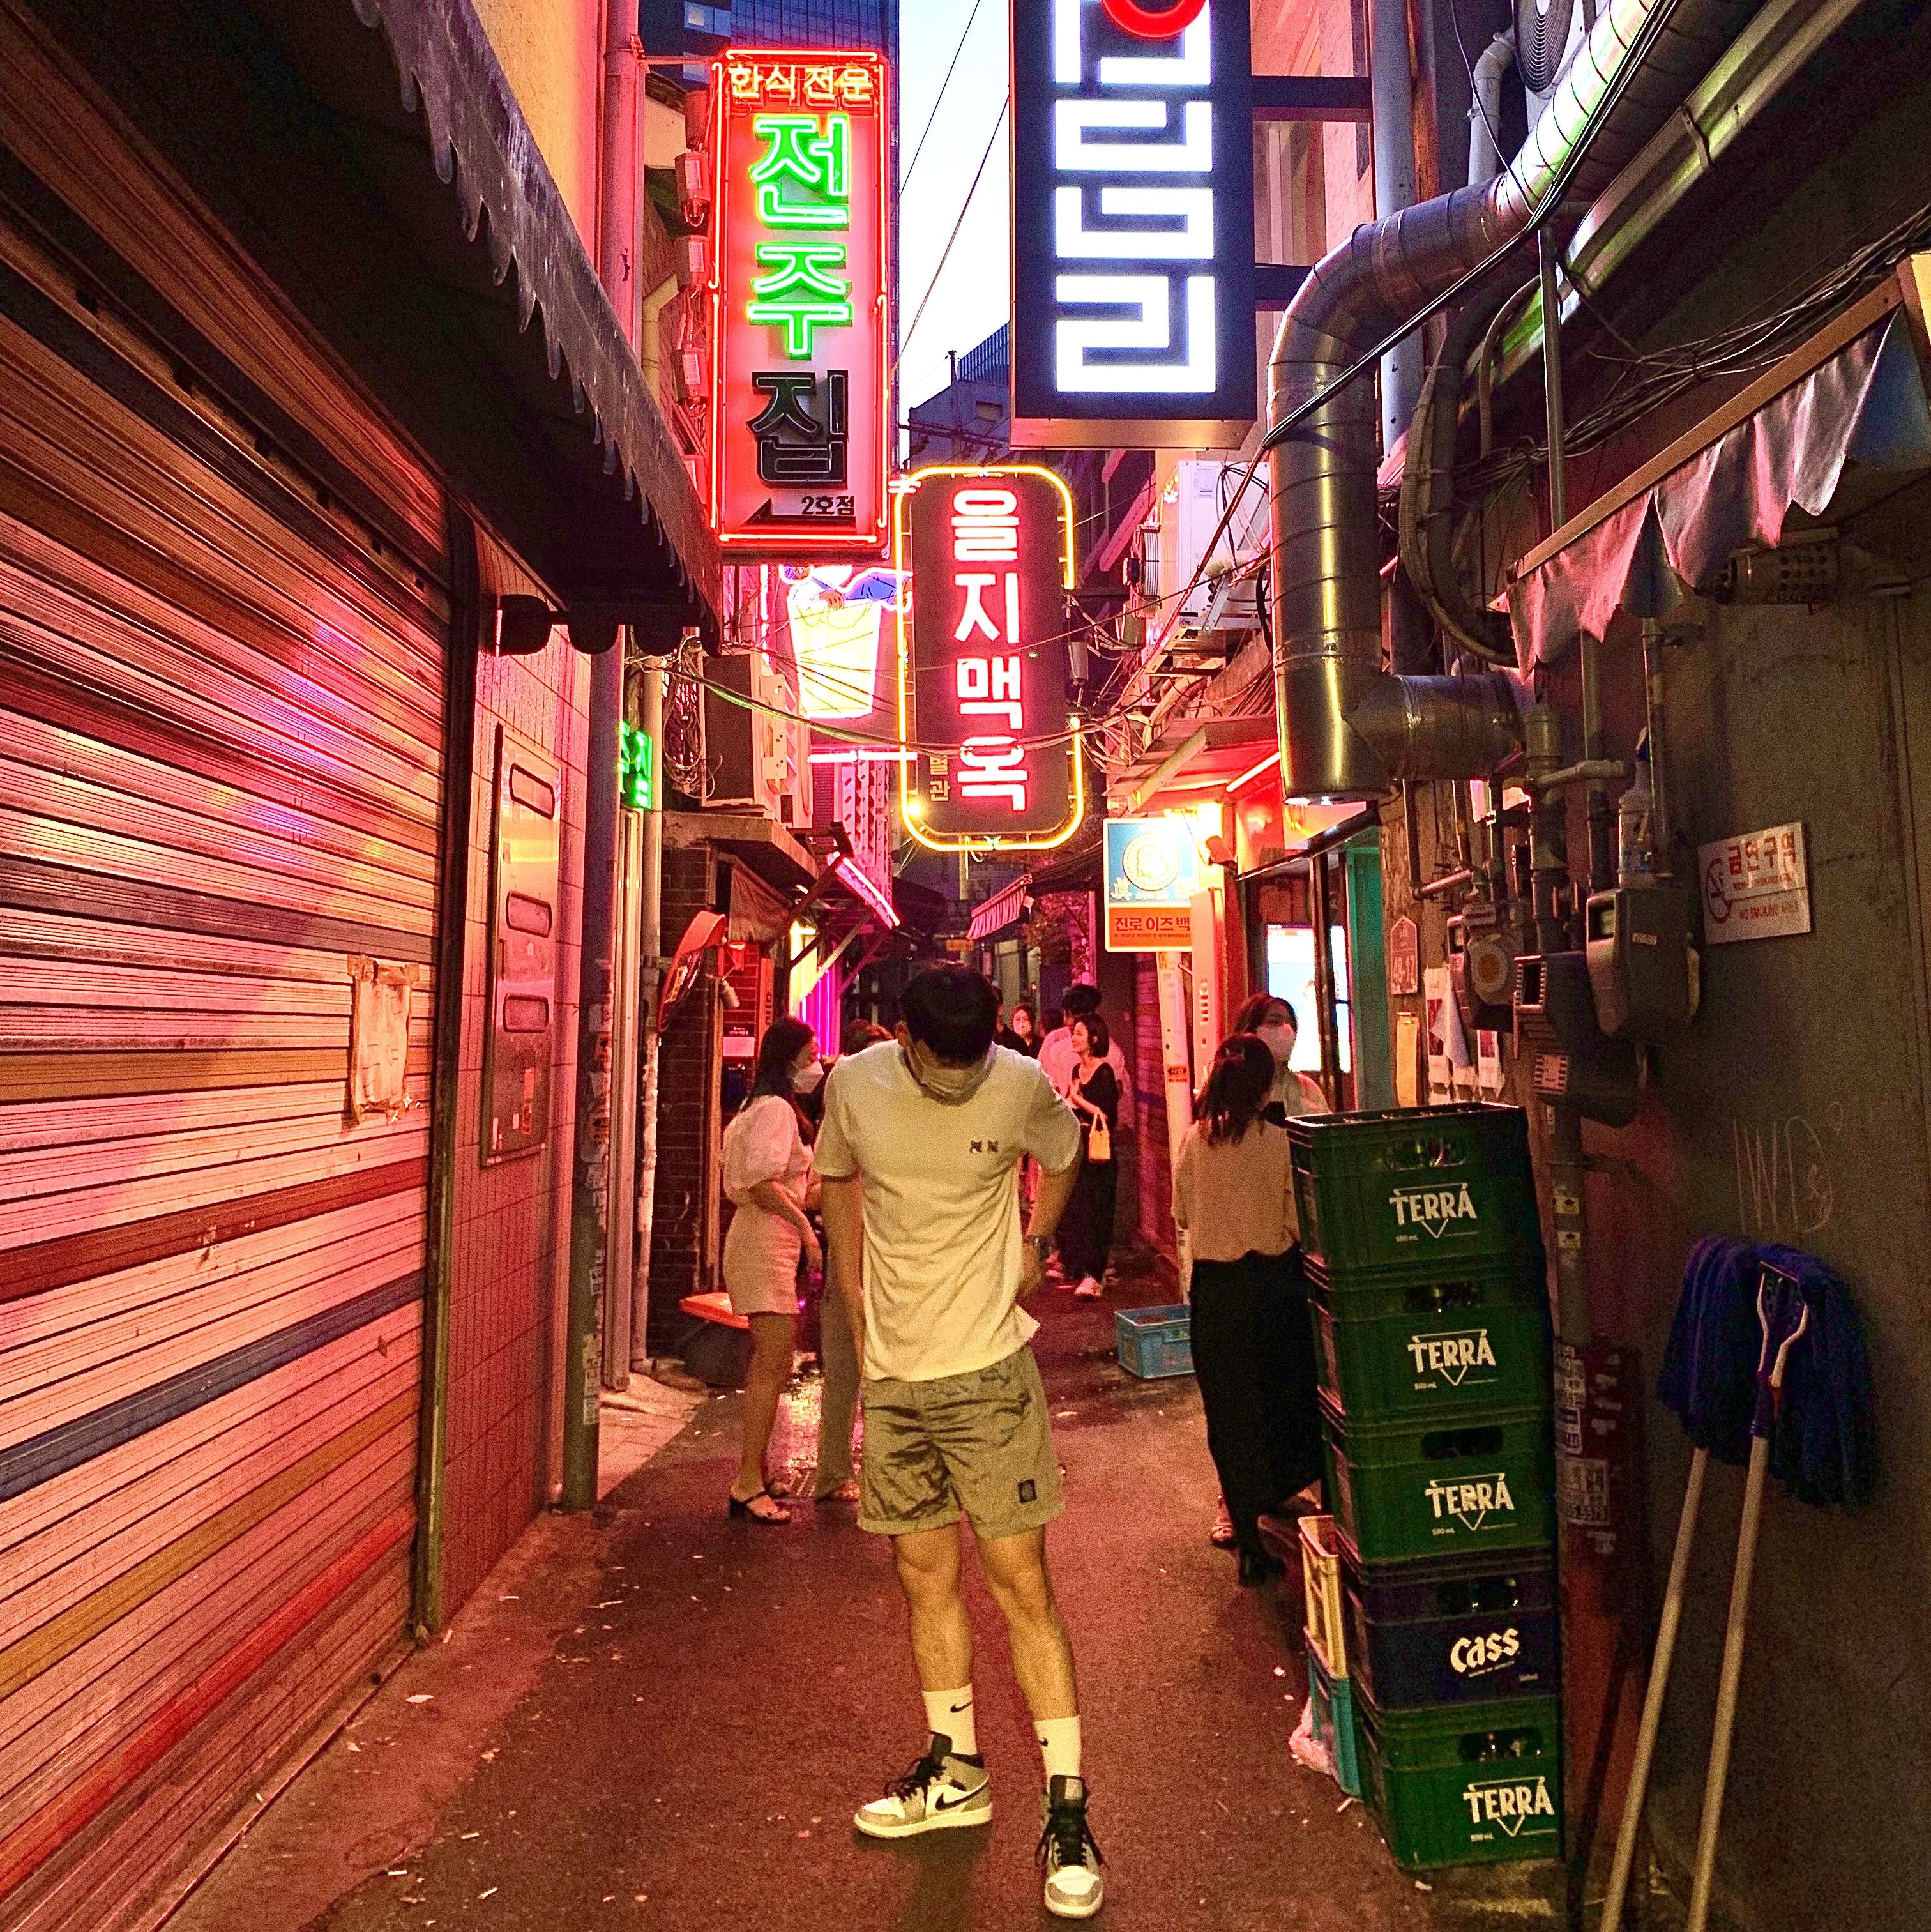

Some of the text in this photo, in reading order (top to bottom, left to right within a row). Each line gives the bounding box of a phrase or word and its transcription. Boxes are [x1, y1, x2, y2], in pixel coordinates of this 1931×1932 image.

[728, 63, 874, 100] 한식전문
[746, 114, 852, 489] 전주집
[801, 495, 855, 516] 2호점
[951, 488, 1028, 812] 을지맥옥
[929, 755, 951, 802] 별관
[1727, 831, 1797, 876] 금연구역
[1114, 917, 1143, 932] 진로
[1146, 917, 1174, 932] 이즈
[1389, 1189, 1477, 1226] TERRA
[1408, 1336, 1497, 1373] TERRA
[1425, 1480, 1515, 1518] TERRA
[1450, 1627, 1520, 1673] Cass
[1463, 1784, 1555, 1823] TERRA
